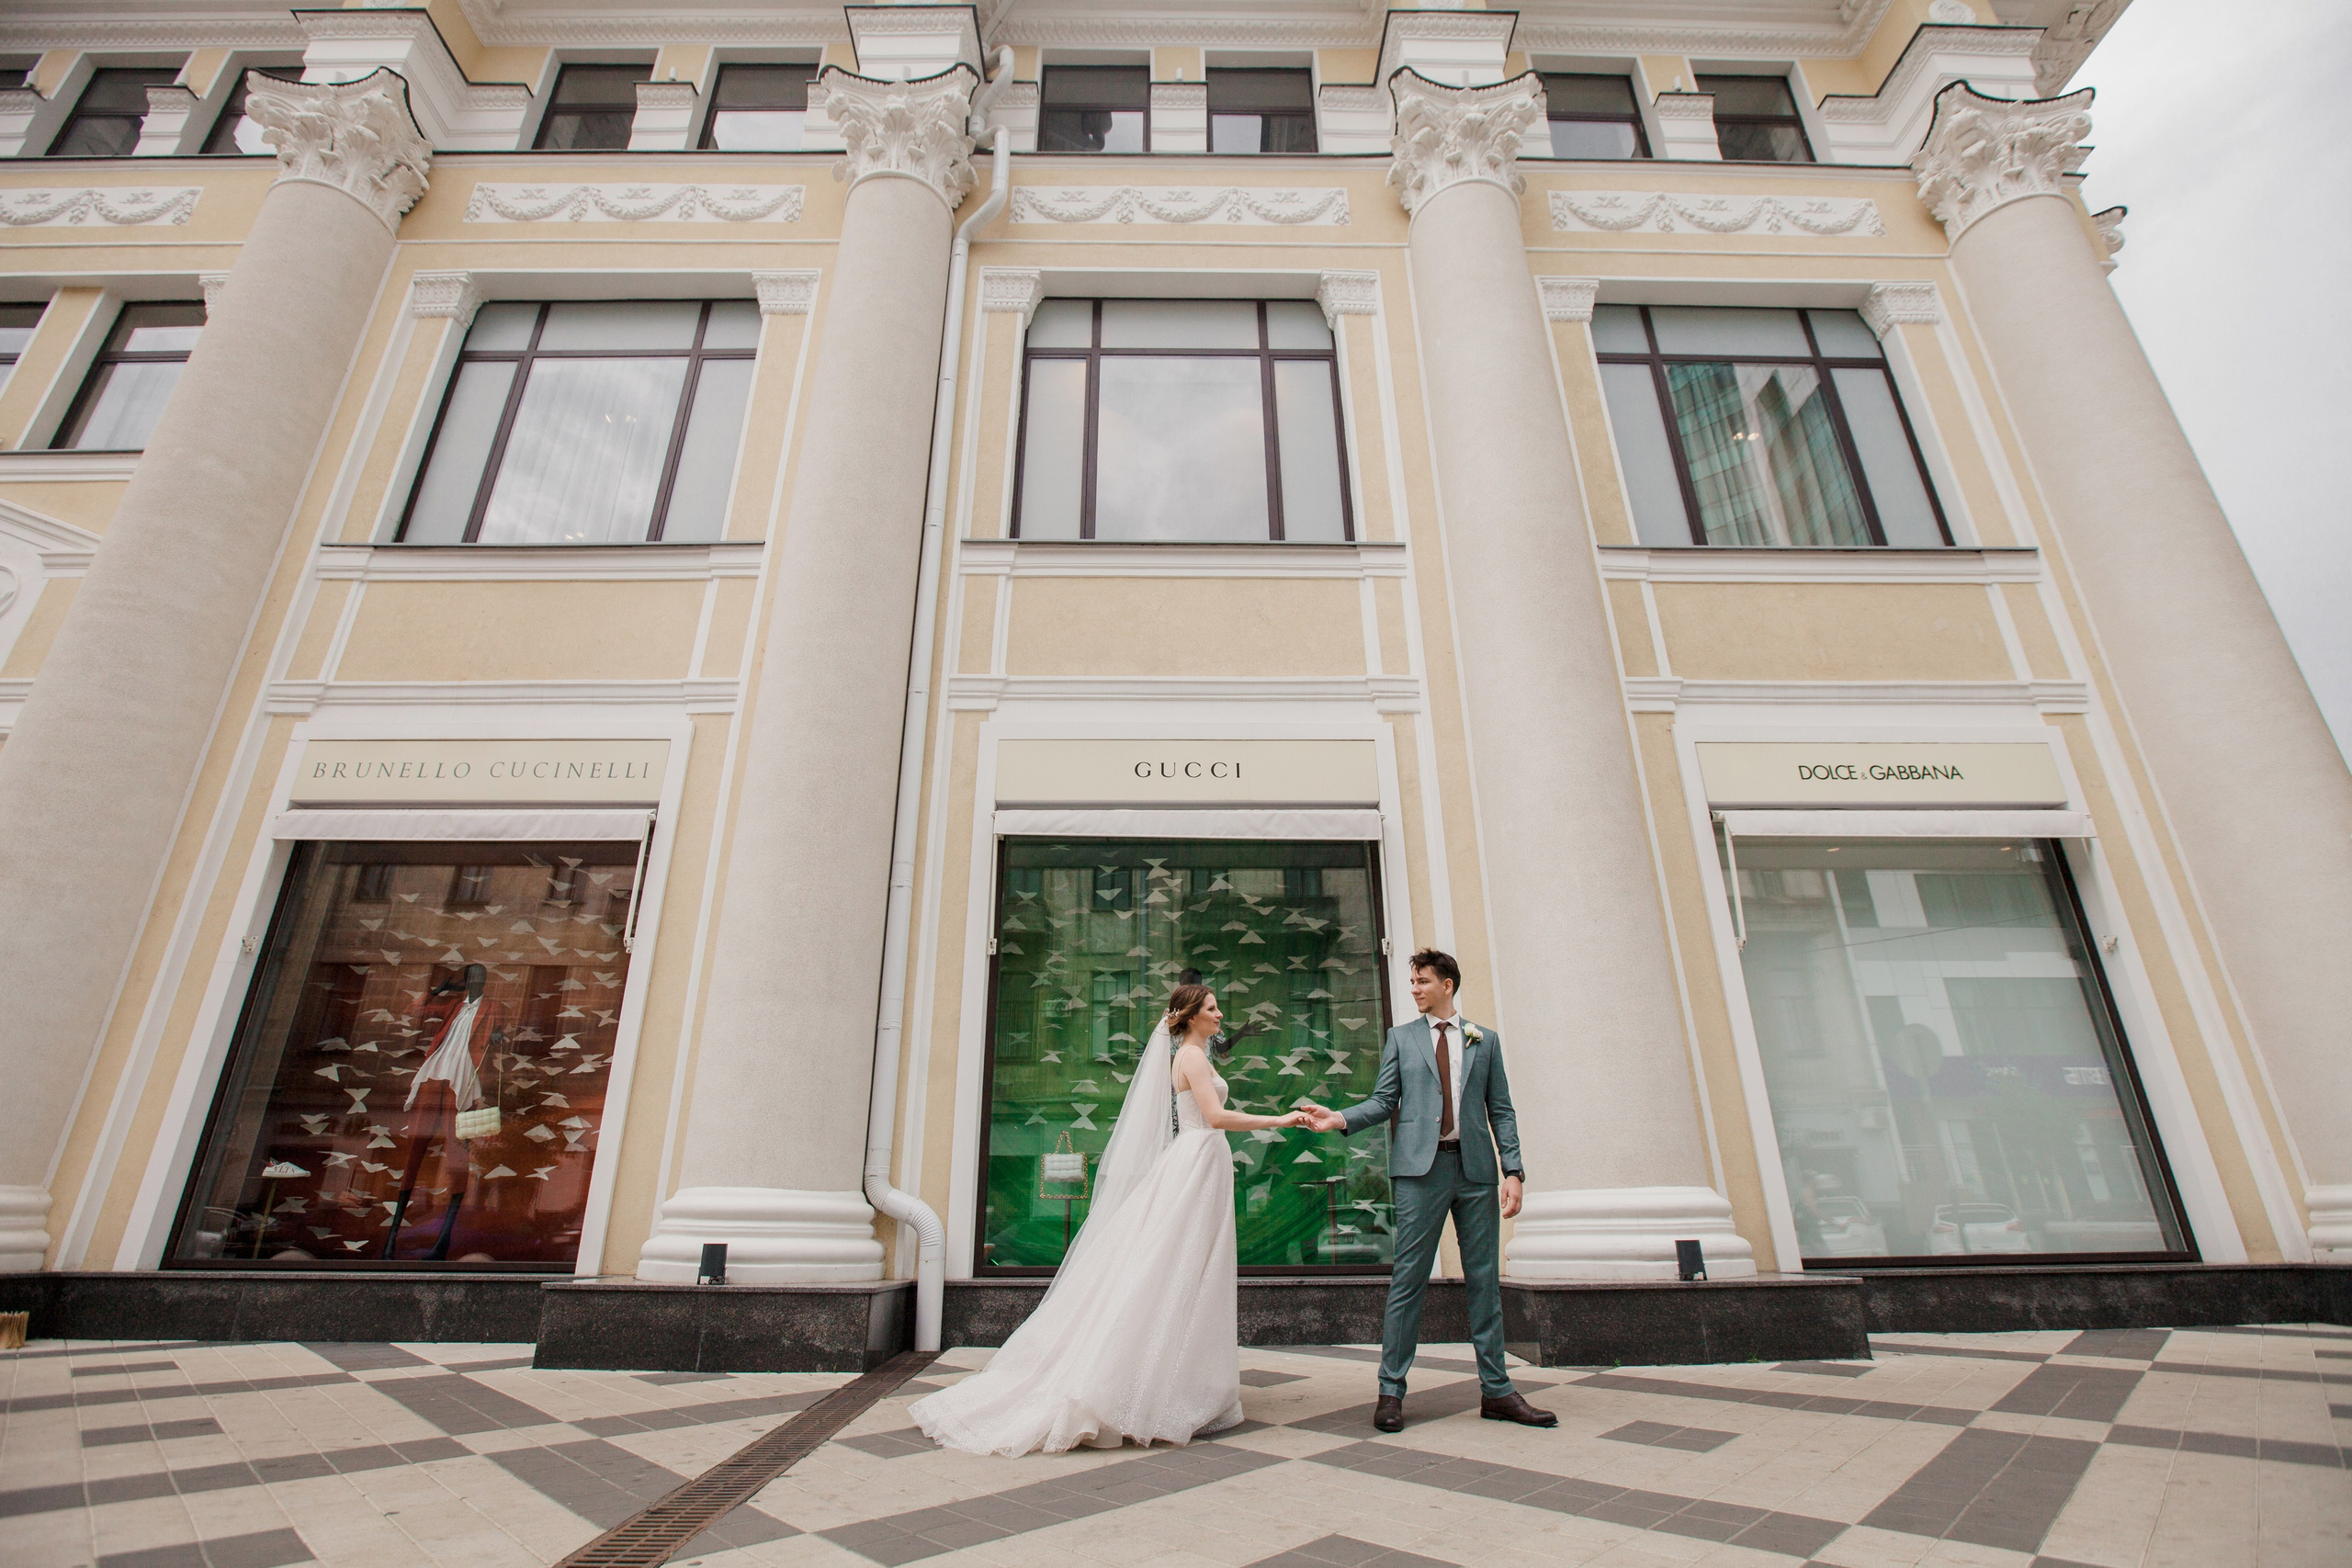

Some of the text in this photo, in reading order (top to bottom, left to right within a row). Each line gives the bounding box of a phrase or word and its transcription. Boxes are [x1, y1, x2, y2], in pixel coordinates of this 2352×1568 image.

[312, 761, 650, 779] BRUNELLO CUCINELLI
[1134, 761, 1241, 779] GUCCI
[1798, 764, 1964, 780] DOLCE & GABBANA
